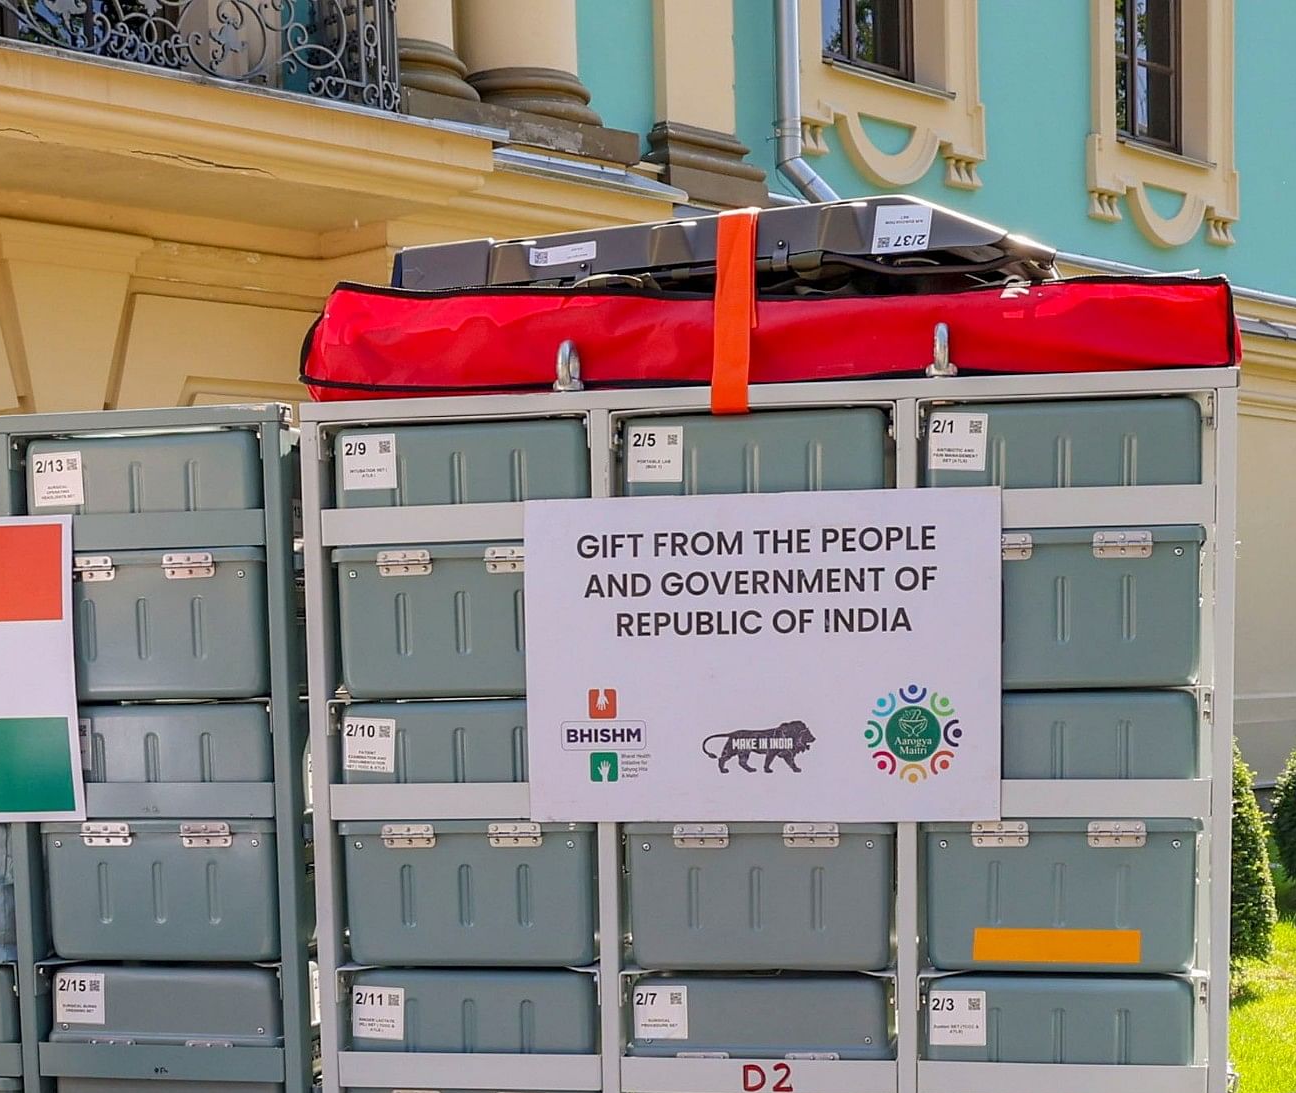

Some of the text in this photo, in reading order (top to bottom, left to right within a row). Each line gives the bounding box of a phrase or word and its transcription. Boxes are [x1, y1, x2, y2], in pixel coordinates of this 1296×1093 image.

[894, 234, 926, 247] 2/37
[932, 420, 954, 434] 2/1
[633, 433, 656, 447] 2/5
[345, 442, 366, 456] 2/9
[35, 459, 63, 473] 2/13
[577, 525, 937, 559] GIFT FROM THE PEOPLE
[584, 566, 937, 598] AND GOVERNMENT OF
[616, 607, 913, 637] REPUBLIC OF INDIA
[346, 724, 375, 737] 2/10
[566, 728, 641, 743] BHISHM
[732, 737, 793, 750] MAKE IN INDIA
[895, 737, 932, 748] Aarogya
[900, 746, 927, 755] Maitri
[59, 978, 86, 992] 2/15
[356, 992, 382, 1006] 2/11
[636, 992, 657, 1005] 2/7
[932, 998, 954, 1011] 2/3
[743, 1062, 793, 1092] D2
